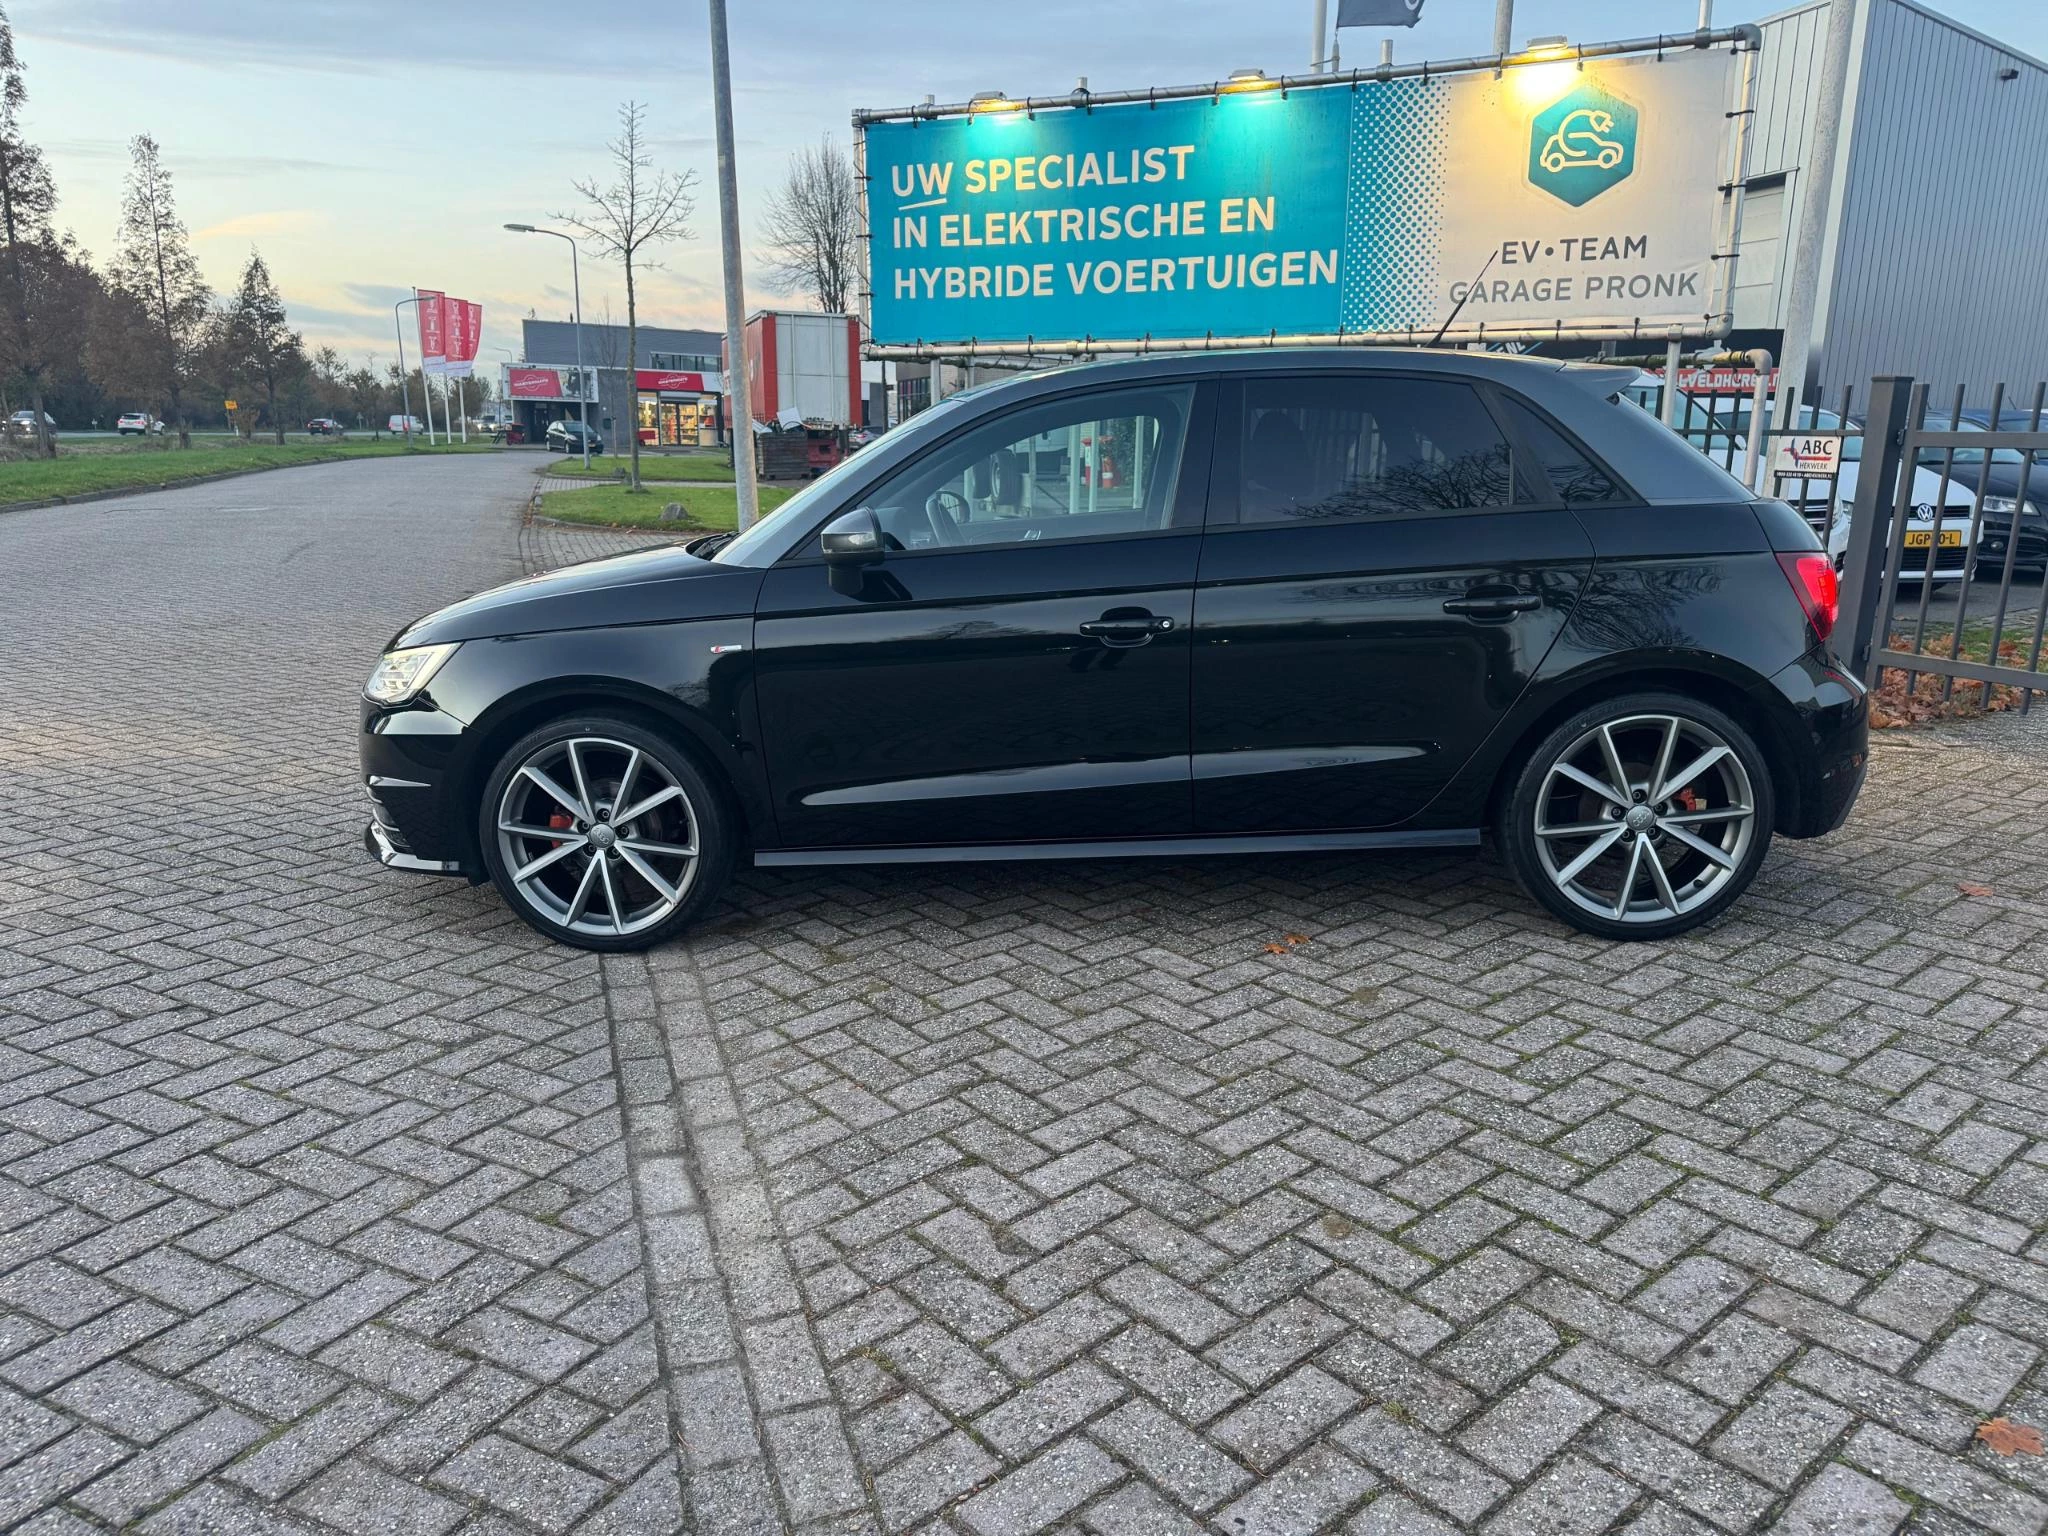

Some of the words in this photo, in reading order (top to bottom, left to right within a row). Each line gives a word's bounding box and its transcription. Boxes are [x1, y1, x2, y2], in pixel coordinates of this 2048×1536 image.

[891, 163, 953, 196] UW
[965, 145, 1195, 193] SPECIALIST
[893, 216, 927, 248] IN
[940, 201, 1205, 247] ELEKTRISCHE
[1220, 196, 1275, 233] EN
[895, 264, 1054, 299] HYBRIDE
[1066, 249, 1338, 295] VOERTUIGEN
[1450, 278, 1572, 304] GARAGE
[1585, 272, 1698, 298] PRONK
[1800, 462, 1828, 470] HEKWERK
[1801, 440, 1833, 455] ABC
